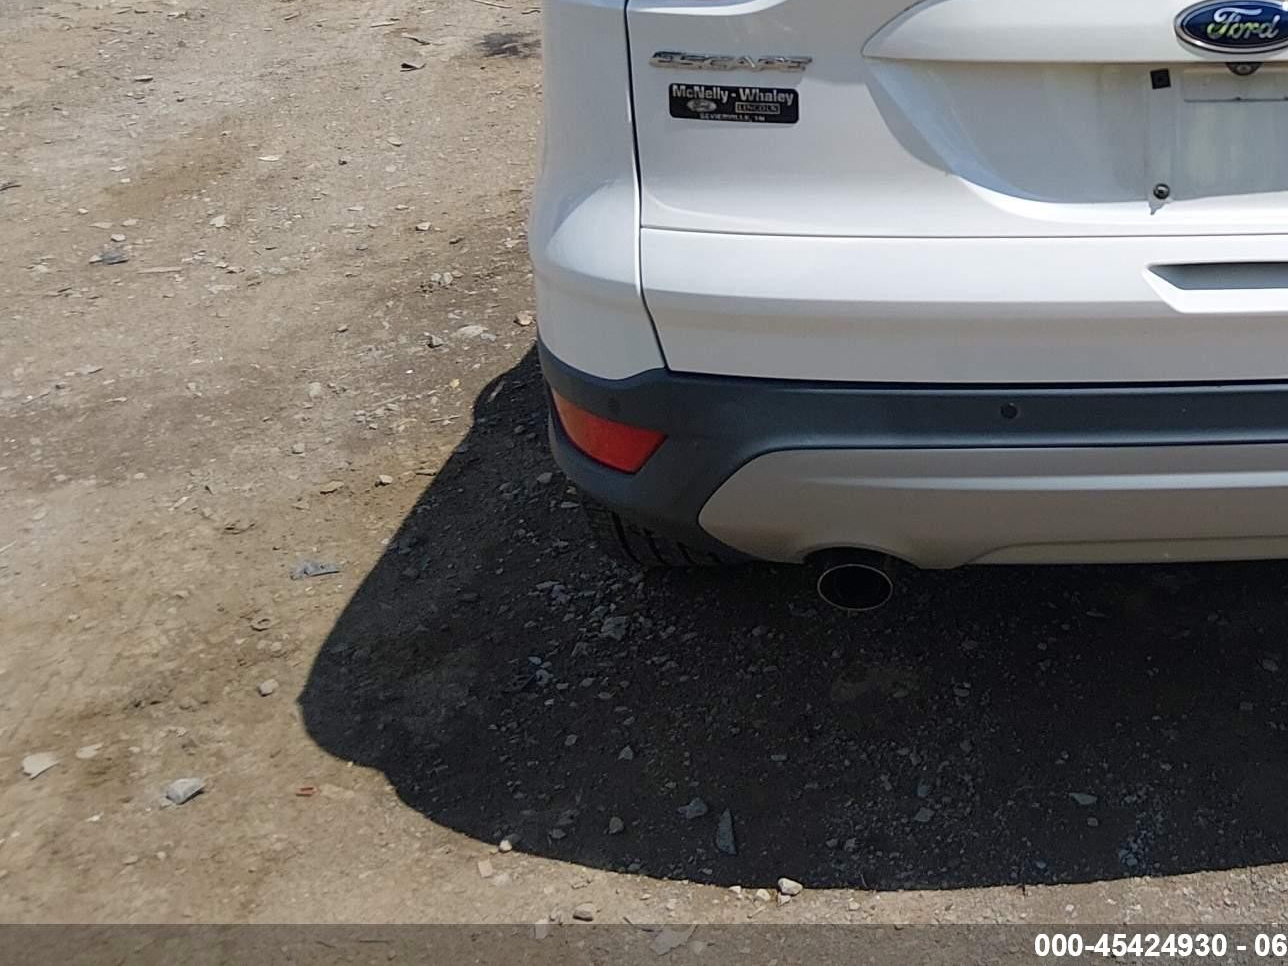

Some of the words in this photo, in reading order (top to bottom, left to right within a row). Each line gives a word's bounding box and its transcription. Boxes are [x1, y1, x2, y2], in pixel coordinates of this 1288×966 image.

[1206, 7, 1281, 40] Ford
[649, 51, 813, 73] ESCAPE
[671, 84, 729, 103] McNelly
[739, 87, 794, 106] Whaley
